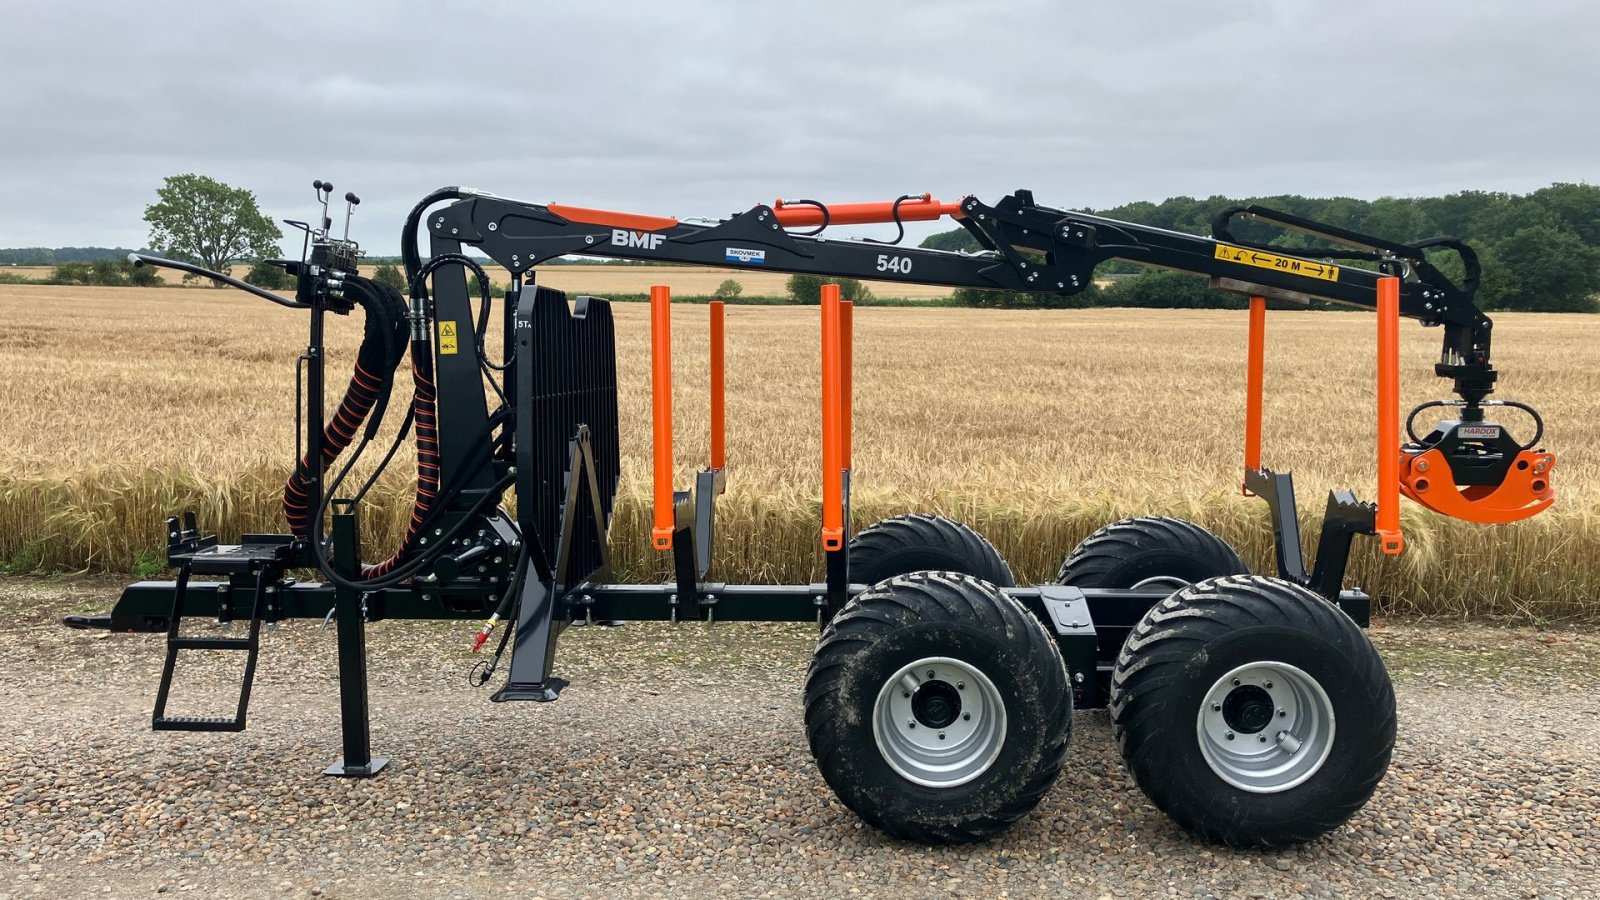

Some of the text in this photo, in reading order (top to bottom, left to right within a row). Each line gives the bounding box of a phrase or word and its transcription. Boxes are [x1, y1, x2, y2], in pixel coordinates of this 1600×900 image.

[611, 229, 667, 250] BMF
[729, 249, 761, 257] SKOVMEK
[876, 254, 912, 274] 540
[1275, 258, 1301, 271] 20 M
[1463, 427, 1497, 435] HARDOX
